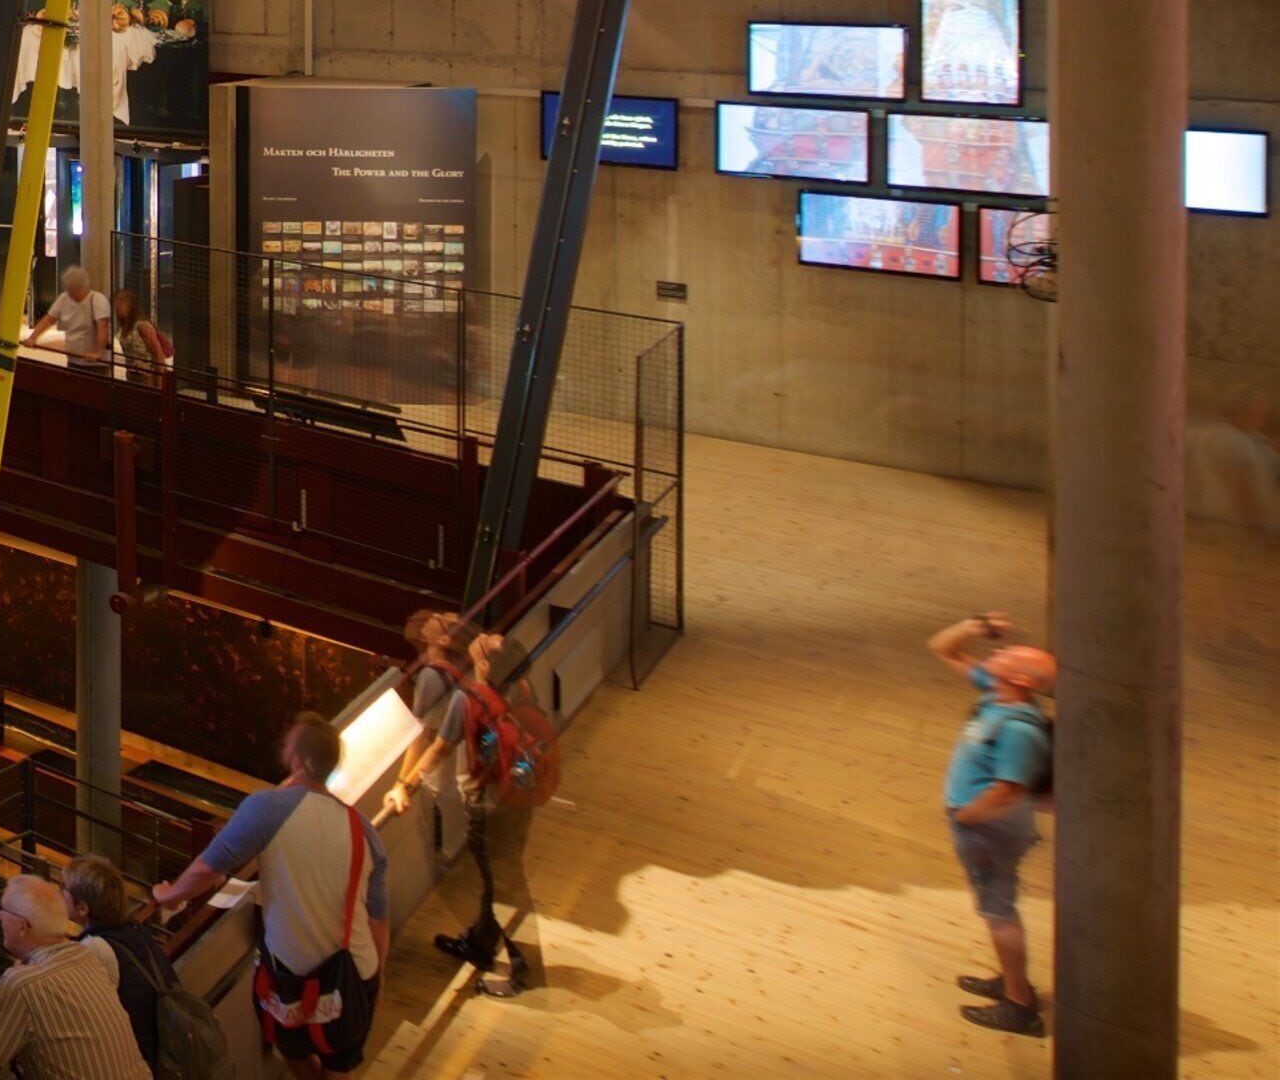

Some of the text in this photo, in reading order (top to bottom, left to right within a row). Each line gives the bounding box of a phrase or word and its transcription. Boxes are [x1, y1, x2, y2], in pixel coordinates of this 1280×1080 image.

[263, 147, 304, 157] MAKTEN
[305, 149, 327, 157] OCH
[331, 166, 465, 178] THE POWER AND THE GLORY
